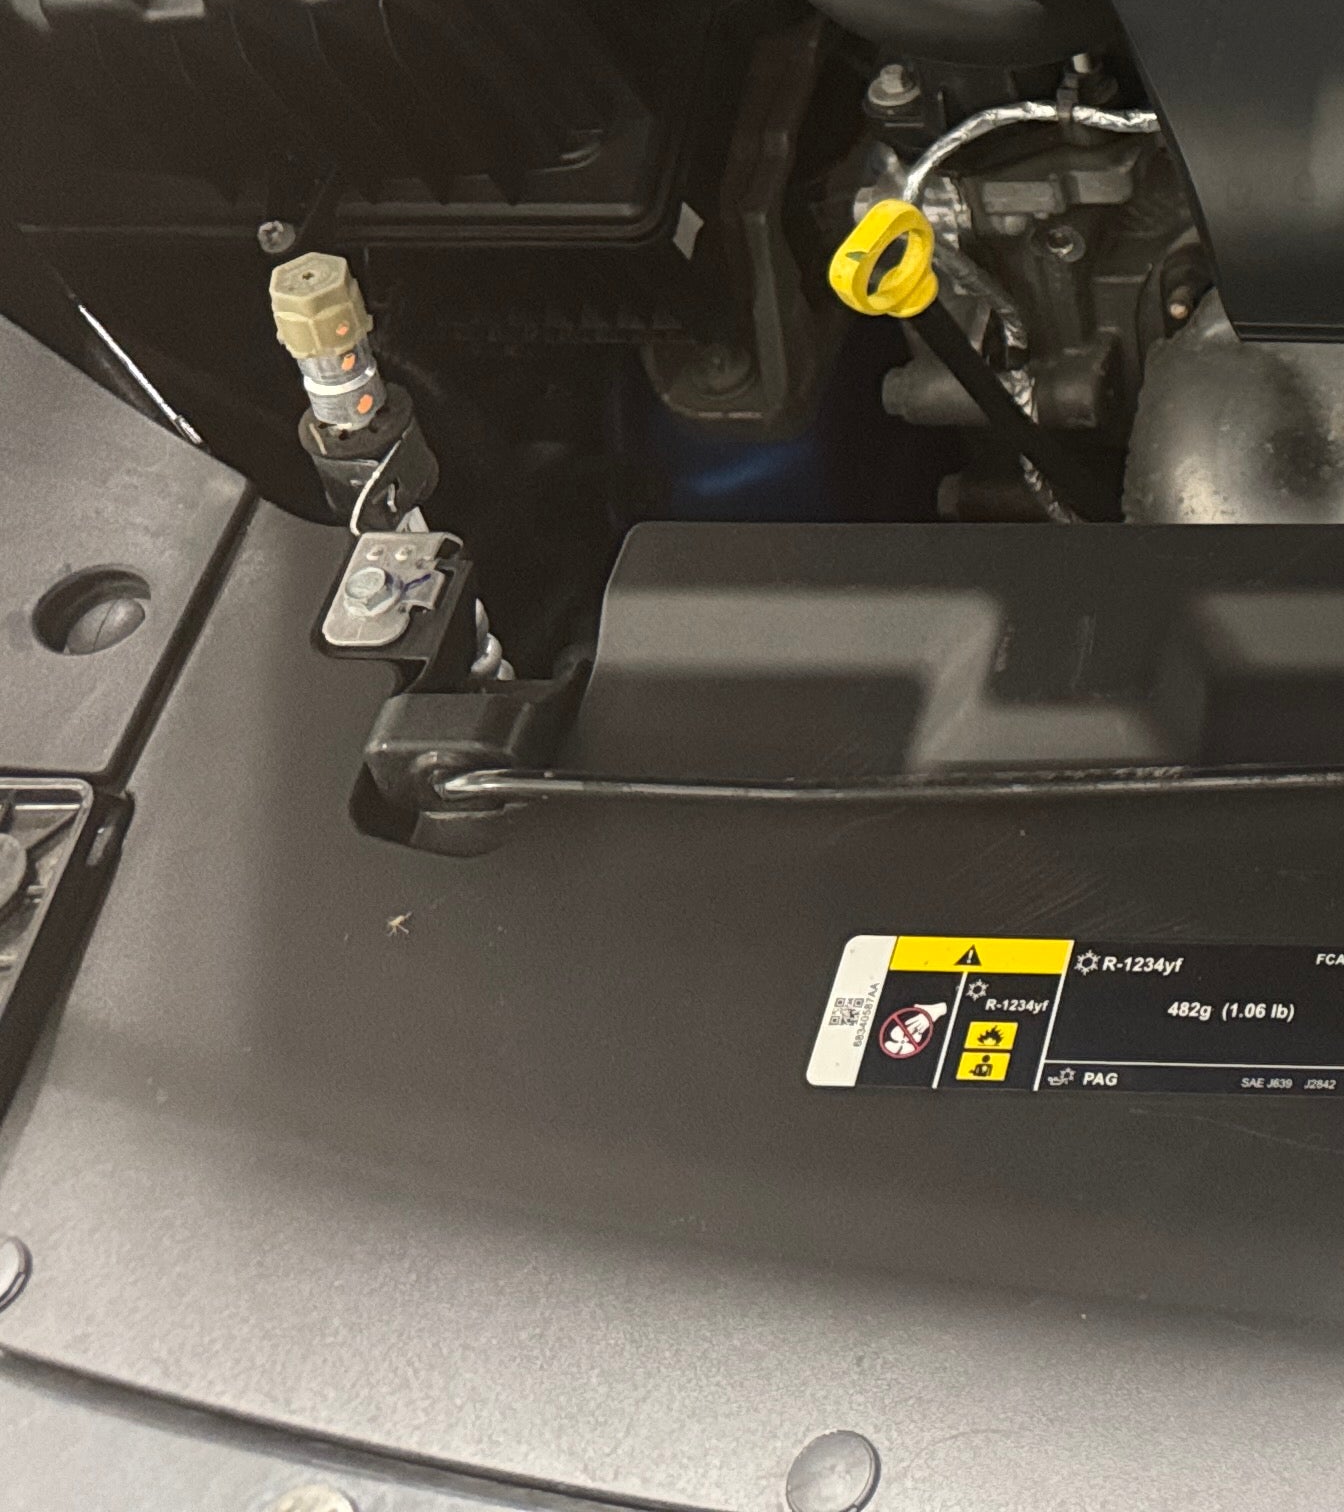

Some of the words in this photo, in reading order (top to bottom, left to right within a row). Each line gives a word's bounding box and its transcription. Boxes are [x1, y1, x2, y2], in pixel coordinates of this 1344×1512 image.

[1102, 955, 1184, 976] R-1234yf
[985, 998, 1049, 1014] R-1234yf
[1167, 1001, 1212, 1021] 482g
[1221, 1002, 1266, 1021] (1.06
[1270, 1003, 1295, 1023] lb)
[1082, 1072, 1118, 1086] PAG
[1240, 1077, 1265, 1088] SAE
[1266, 1078, 1293, 1089] J639
